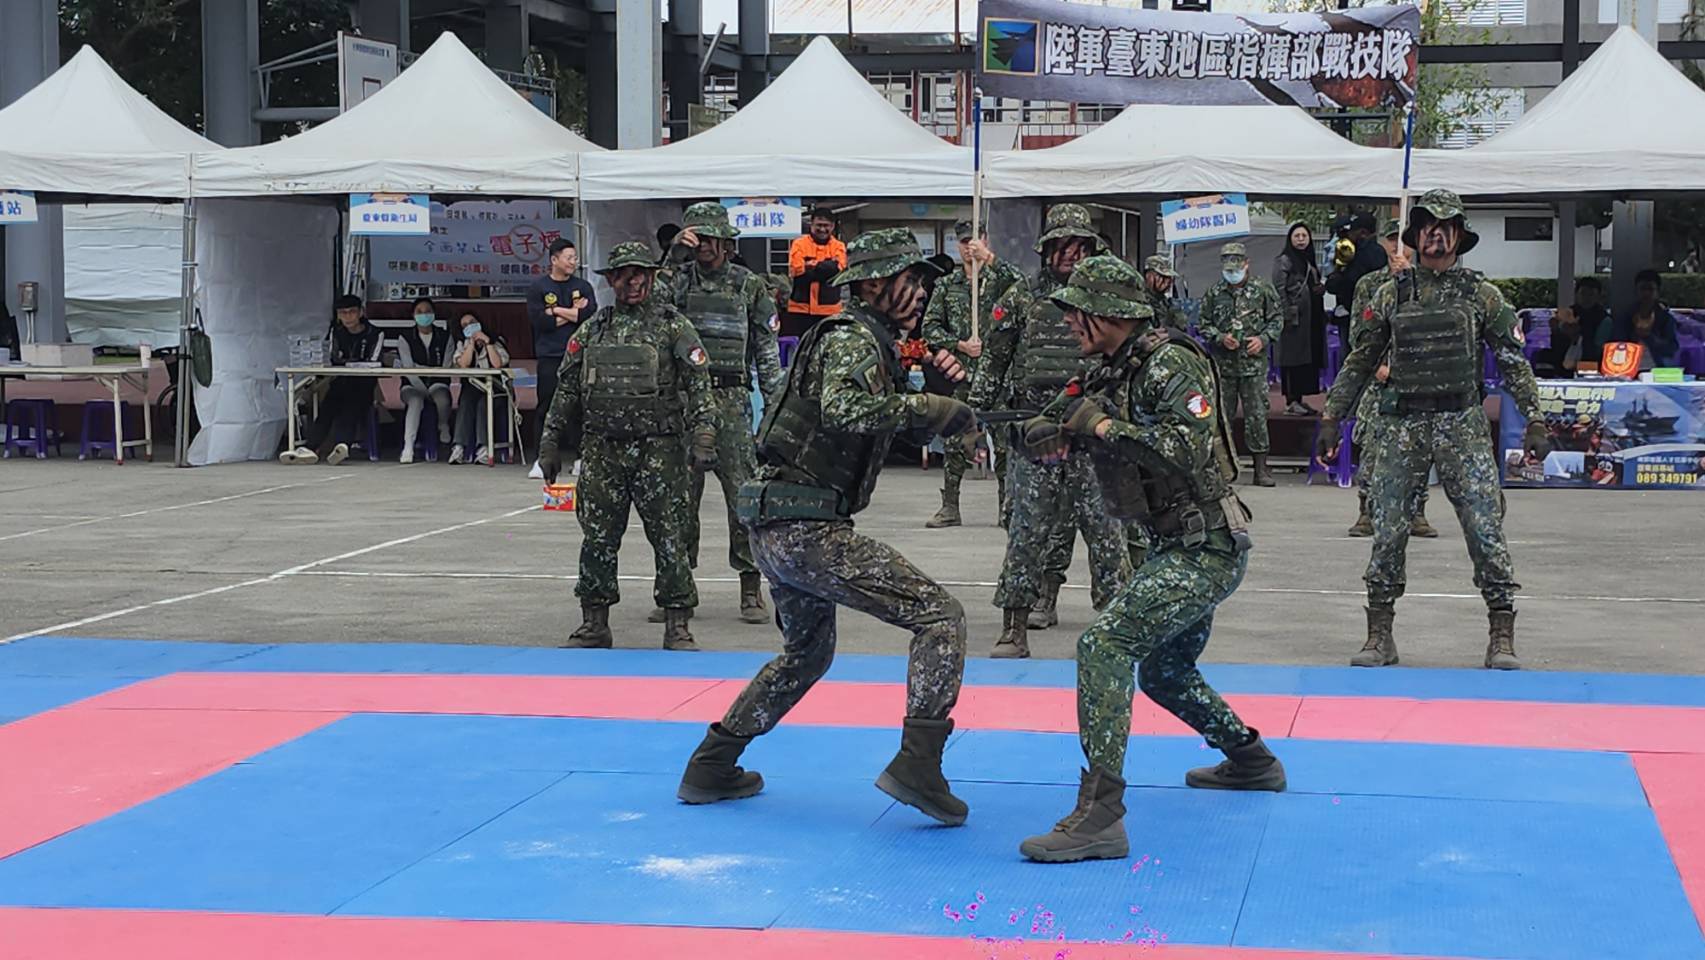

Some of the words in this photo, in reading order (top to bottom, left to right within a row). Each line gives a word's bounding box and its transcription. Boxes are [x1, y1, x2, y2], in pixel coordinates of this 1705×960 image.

[1045, 24, 1412, 80] 陸軍臺東地區指揮部戰技隊
[1636, 472, 1658, 485] 089
[1658, 472, 1698, 485] 349791
